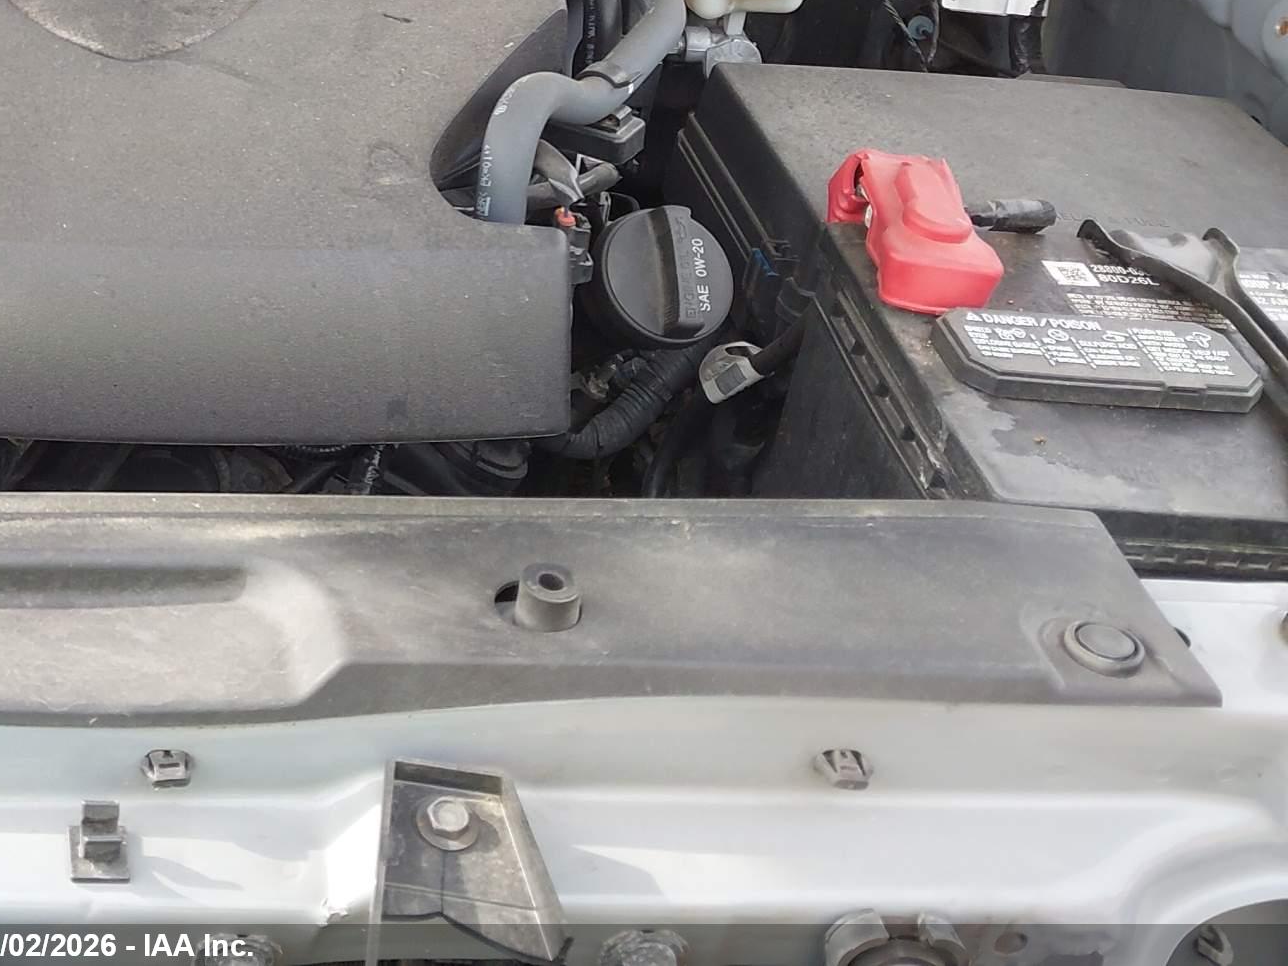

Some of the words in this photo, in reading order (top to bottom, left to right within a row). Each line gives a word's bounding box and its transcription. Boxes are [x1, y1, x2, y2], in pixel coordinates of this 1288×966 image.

[691, 238, 707, 277] 0W-20
[696, 285, 711, 312] SAE
[981, 314, 1038, 327] DANGER
[1048, 318, 1102, 331] POISON
